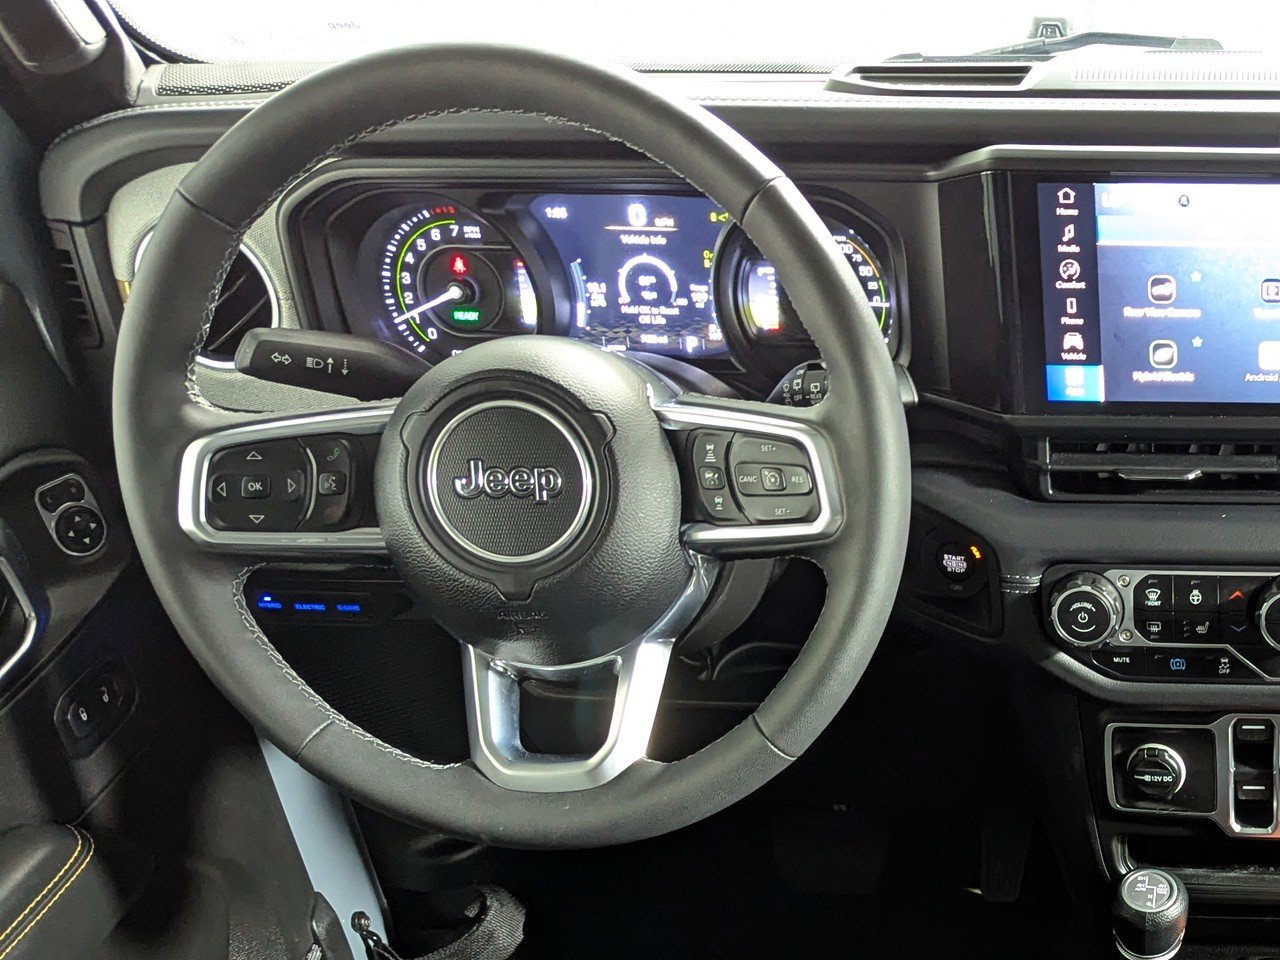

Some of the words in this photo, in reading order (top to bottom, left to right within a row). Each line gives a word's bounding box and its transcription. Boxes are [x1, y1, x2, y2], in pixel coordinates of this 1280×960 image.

[628, 203, 647, 227] 0
[1056, 207, 1079, 216] Home
[430, 228, 441, 241] 6
[450, 225, 459, 237] 7
[416, 239, 426, 251] 5
[404, 252, 415, 264] 4
[858, 265, 873, 277] 50
[401, 272, 411, 284] 3
[403, 291, 414, 304] 2
[1060, 317, 1085, 325] Phone
[427, 327, 438, 339] 0
[686, 336, 698, 352] P
[1061, 352, 1087, 361] Vehicle
[1244, 372, 1278, 382] Android
[760, 444, 776, 452] SET+
[454, 458, 562, 504] Jeep
[738, 475, 757, 484] CANC
[791, 475, 804, 484] RES
[248, 481, 263, 491] OK
[943, 554, 965, 562] START
